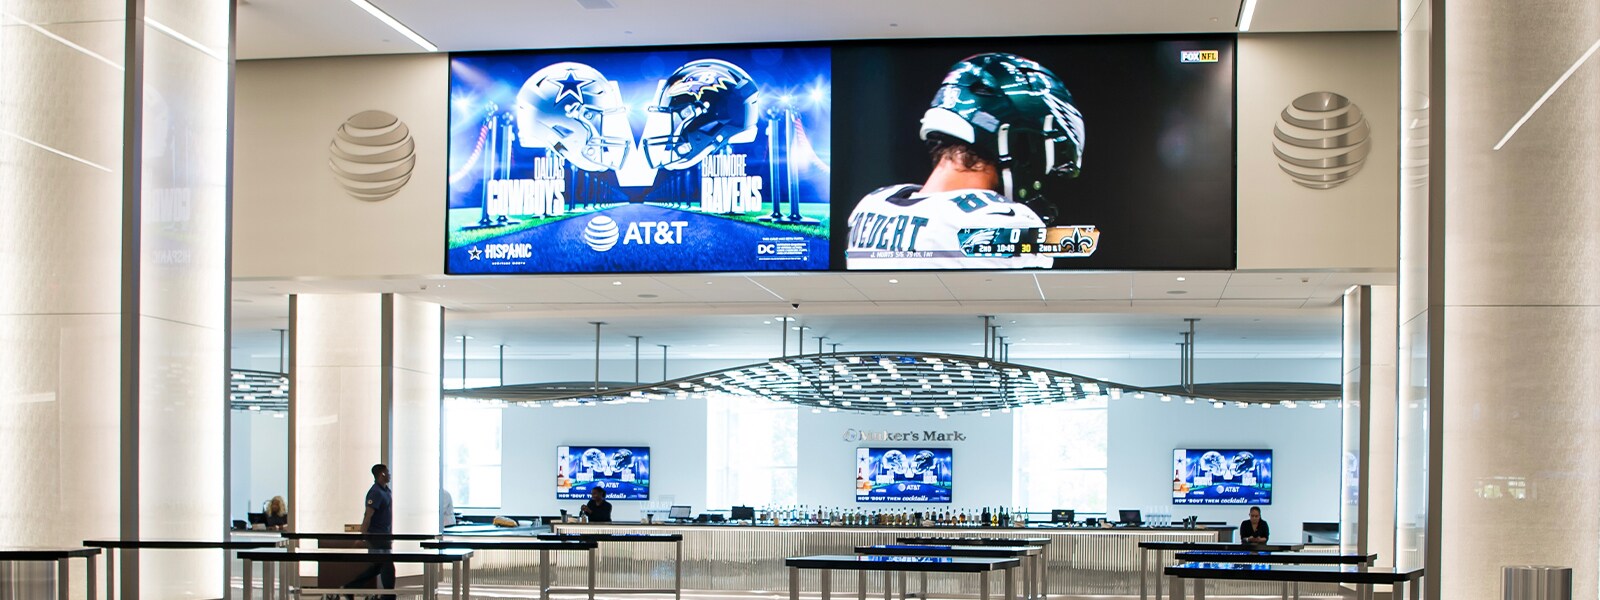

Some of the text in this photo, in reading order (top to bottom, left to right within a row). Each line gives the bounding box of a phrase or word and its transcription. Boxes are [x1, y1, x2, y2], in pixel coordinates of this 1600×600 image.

[1201, 52, 1217, 61] NFL
[534, 157, 565, 180] DALLAS
[702, 154, 747, 176] BALTIMORE
[487, 179, 565, 216] COWBOYS
[702, 176, 762, 213] RAVENS
[623, 221, 688, 245] AT&T
[1010, 229, 1047, 243] 0 3
[485, 243, 532, 260] HISPANIC
[758, 244, 775, 254] DC
[979, 244, 991, 252] 2ND
[1021, 244, 1031, 253] 30
[1039, 244, 1052, 252] 2ND
[923, 430, 966, 441] Mark
